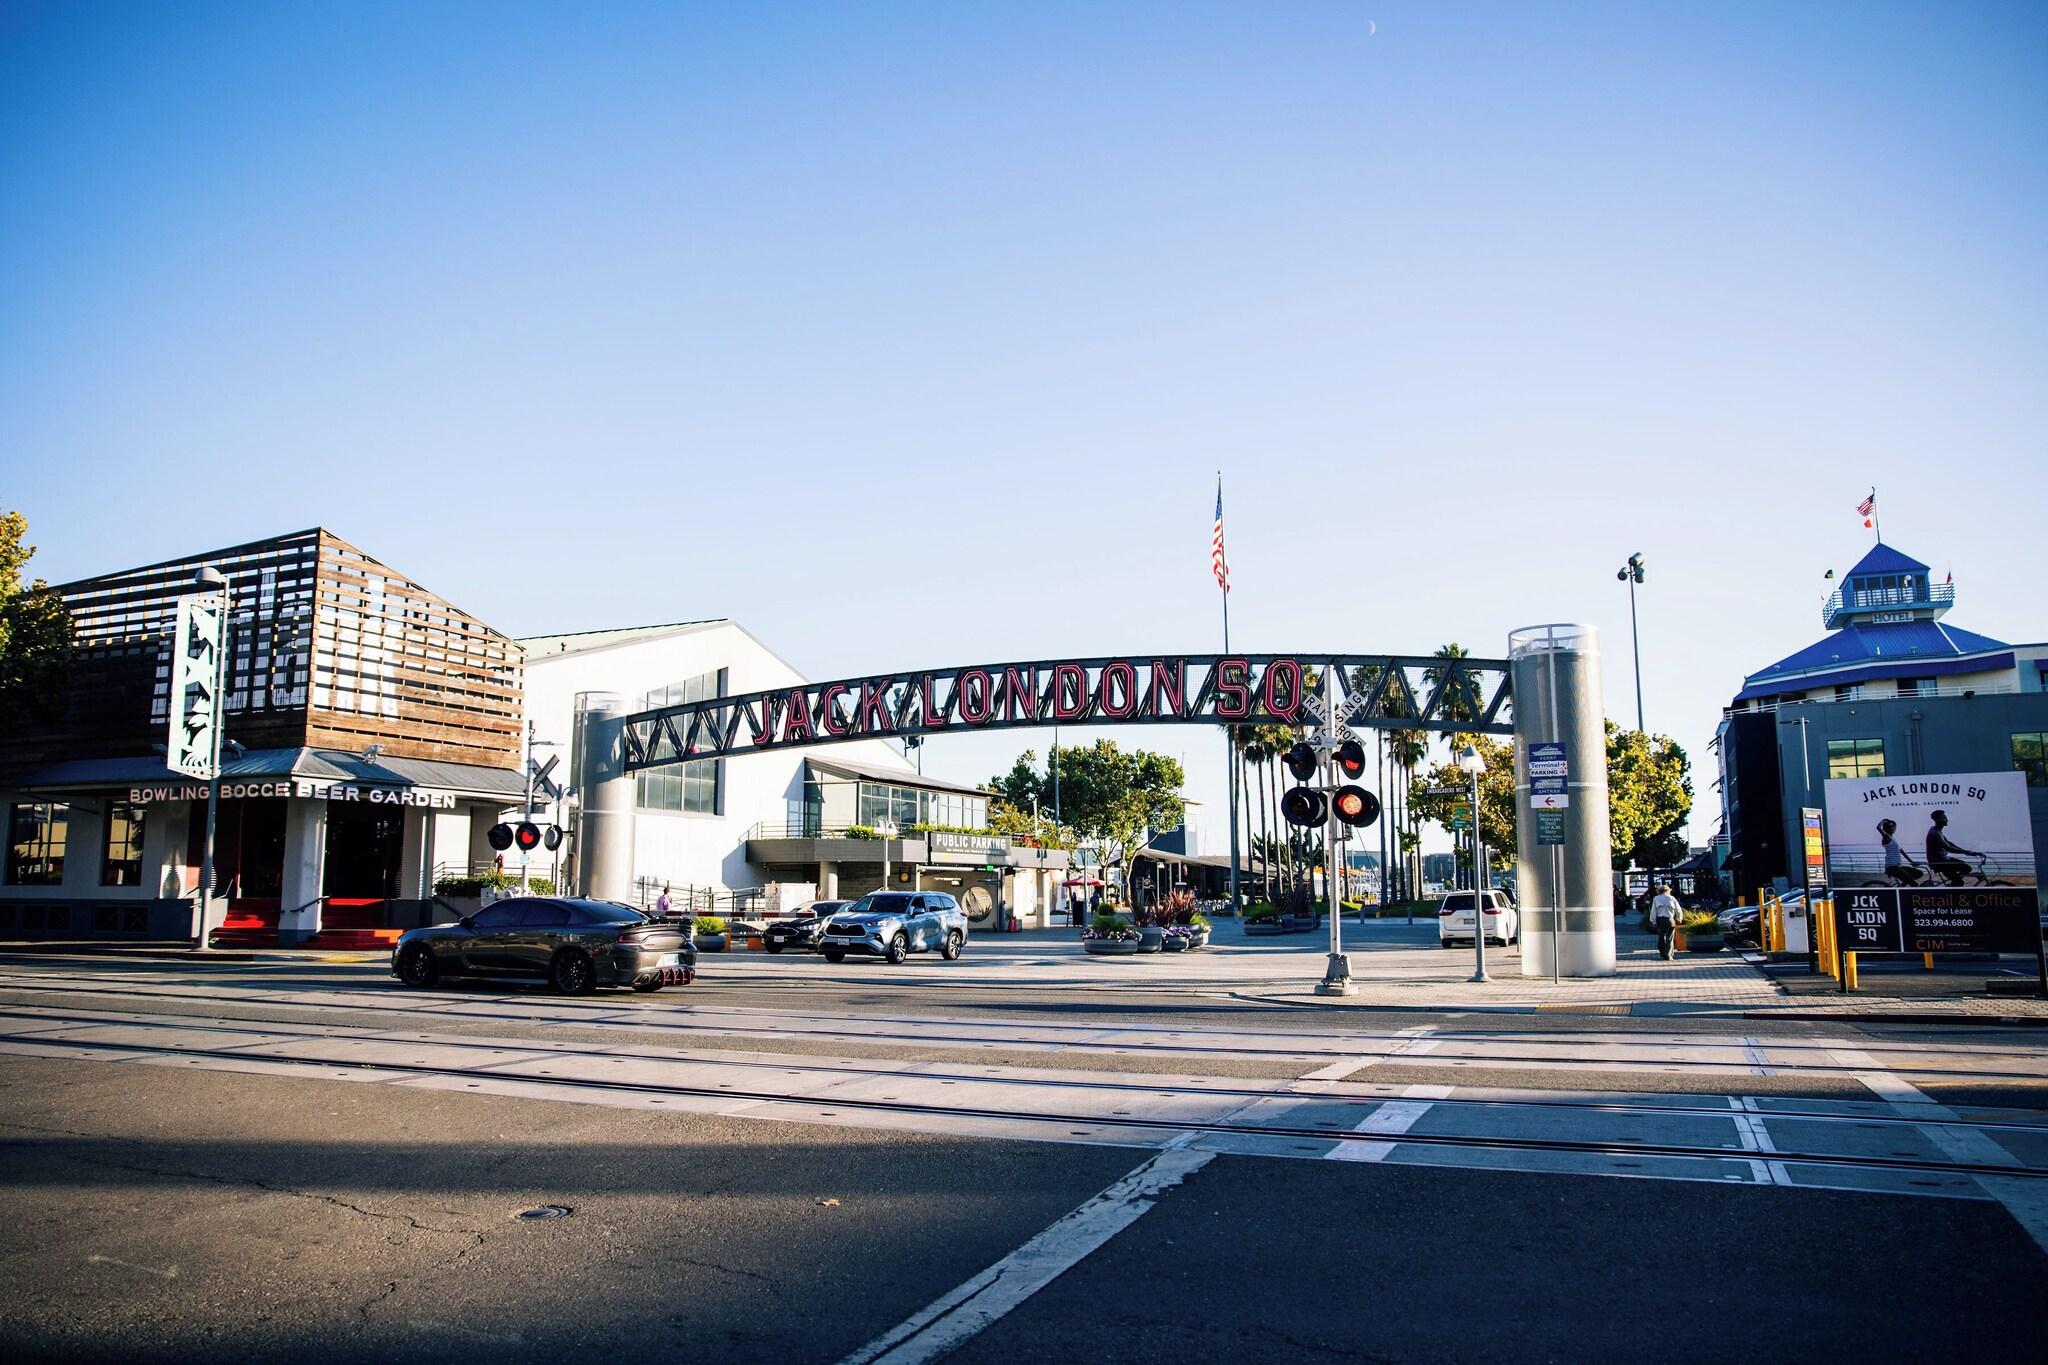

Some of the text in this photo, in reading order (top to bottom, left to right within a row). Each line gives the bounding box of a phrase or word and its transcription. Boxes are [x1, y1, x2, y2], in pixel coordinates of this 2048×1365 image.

[1873, 612, 1912, 622] HOTEL
[753, 657, 1304, 746] JACK LONDON SQ
[130, 782, 290, 802] BOWLING BOCCE
[297, 784, 456, 808] BEER GARDEN
[1863, 782, 1987, 803] JACK LONDON SQ
[936, 834, 1006, 850] PUBLIC PARKING
[1851, 895, 1879, 907] JCK
[1911, 893, 2021, 907] Retail & Office
[1847, 911, 1887, 923] LNDN
[1913, 908, 1936, 916] Space
[1914, 918, 1974, 927] 323.994.6800
[1858, 928, 1877, 941] SQ
[1915, 939, 1945, 950] CIM
